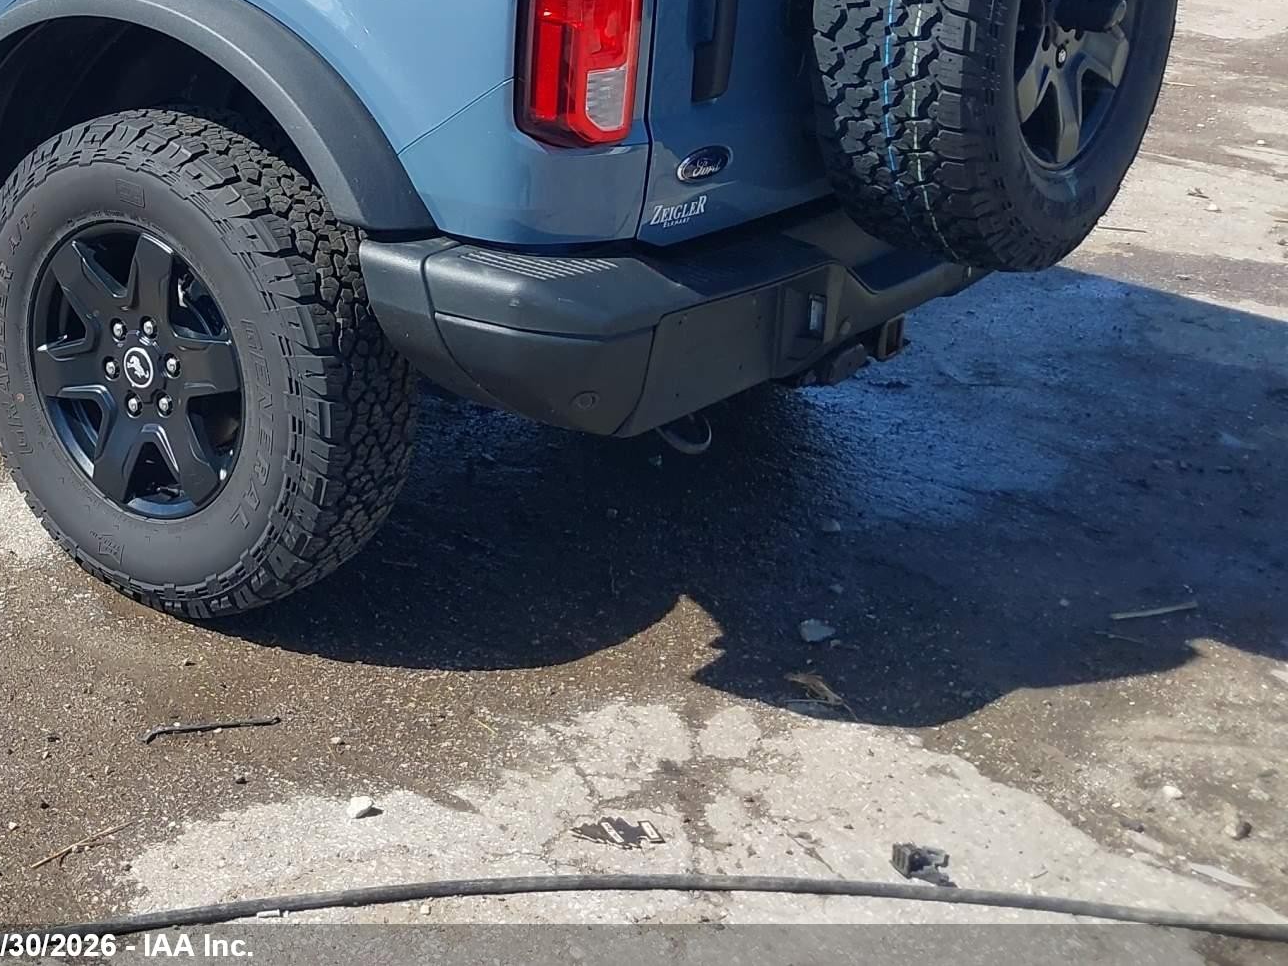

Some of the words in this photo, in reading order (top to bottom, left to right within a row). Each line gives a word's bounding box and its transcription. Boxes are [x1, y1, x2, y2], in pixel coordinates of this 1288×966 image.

[691, 159, 722, 178] Ford
[649, 195, 708, 226] ZEIGLER
[229, 318, 275, 531] GENERAL
